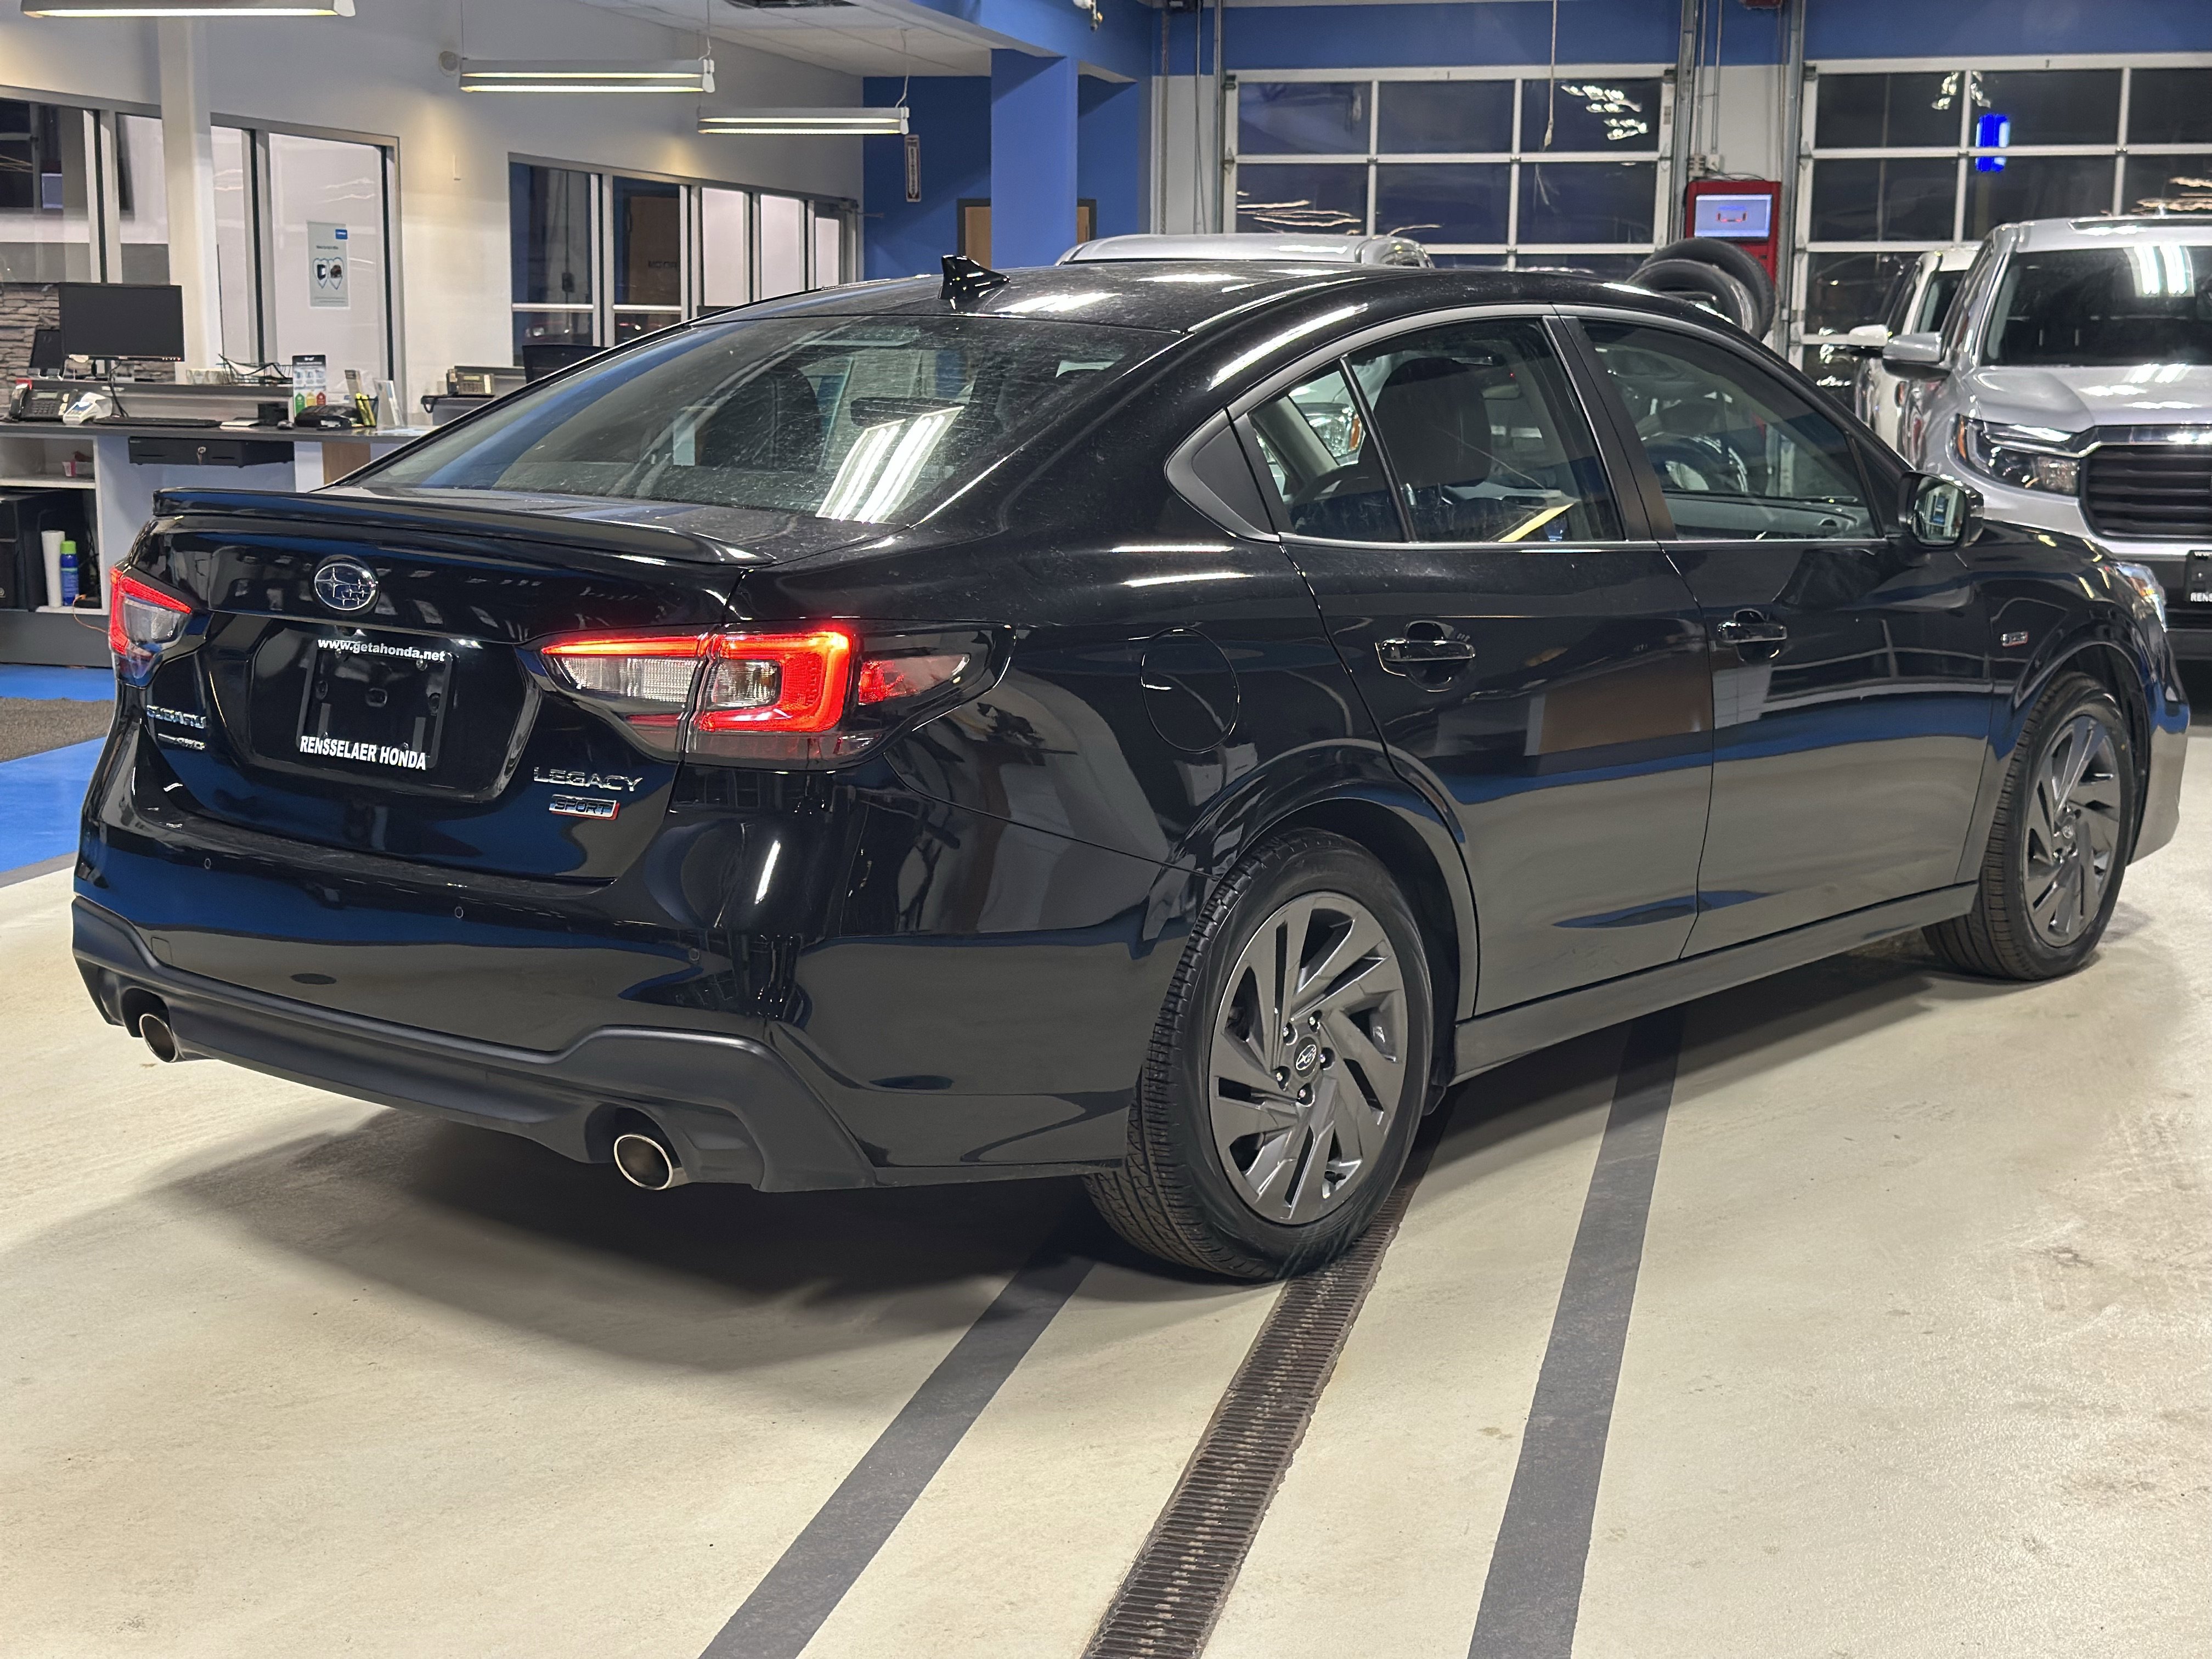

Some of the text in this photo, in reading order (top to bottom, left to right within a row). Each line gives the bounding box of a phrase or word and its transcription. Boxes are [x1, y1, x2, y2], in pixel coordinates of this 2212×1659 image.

[318, 639, 445, 662] www.getahonda.net
[146, 704, 206, 729] SUBARU
[300, 735, 426, 770] RENSSELAER HONDA
[533, 766, 644, 792] LEGACY
[554, 797, 614, 815] SPORT
